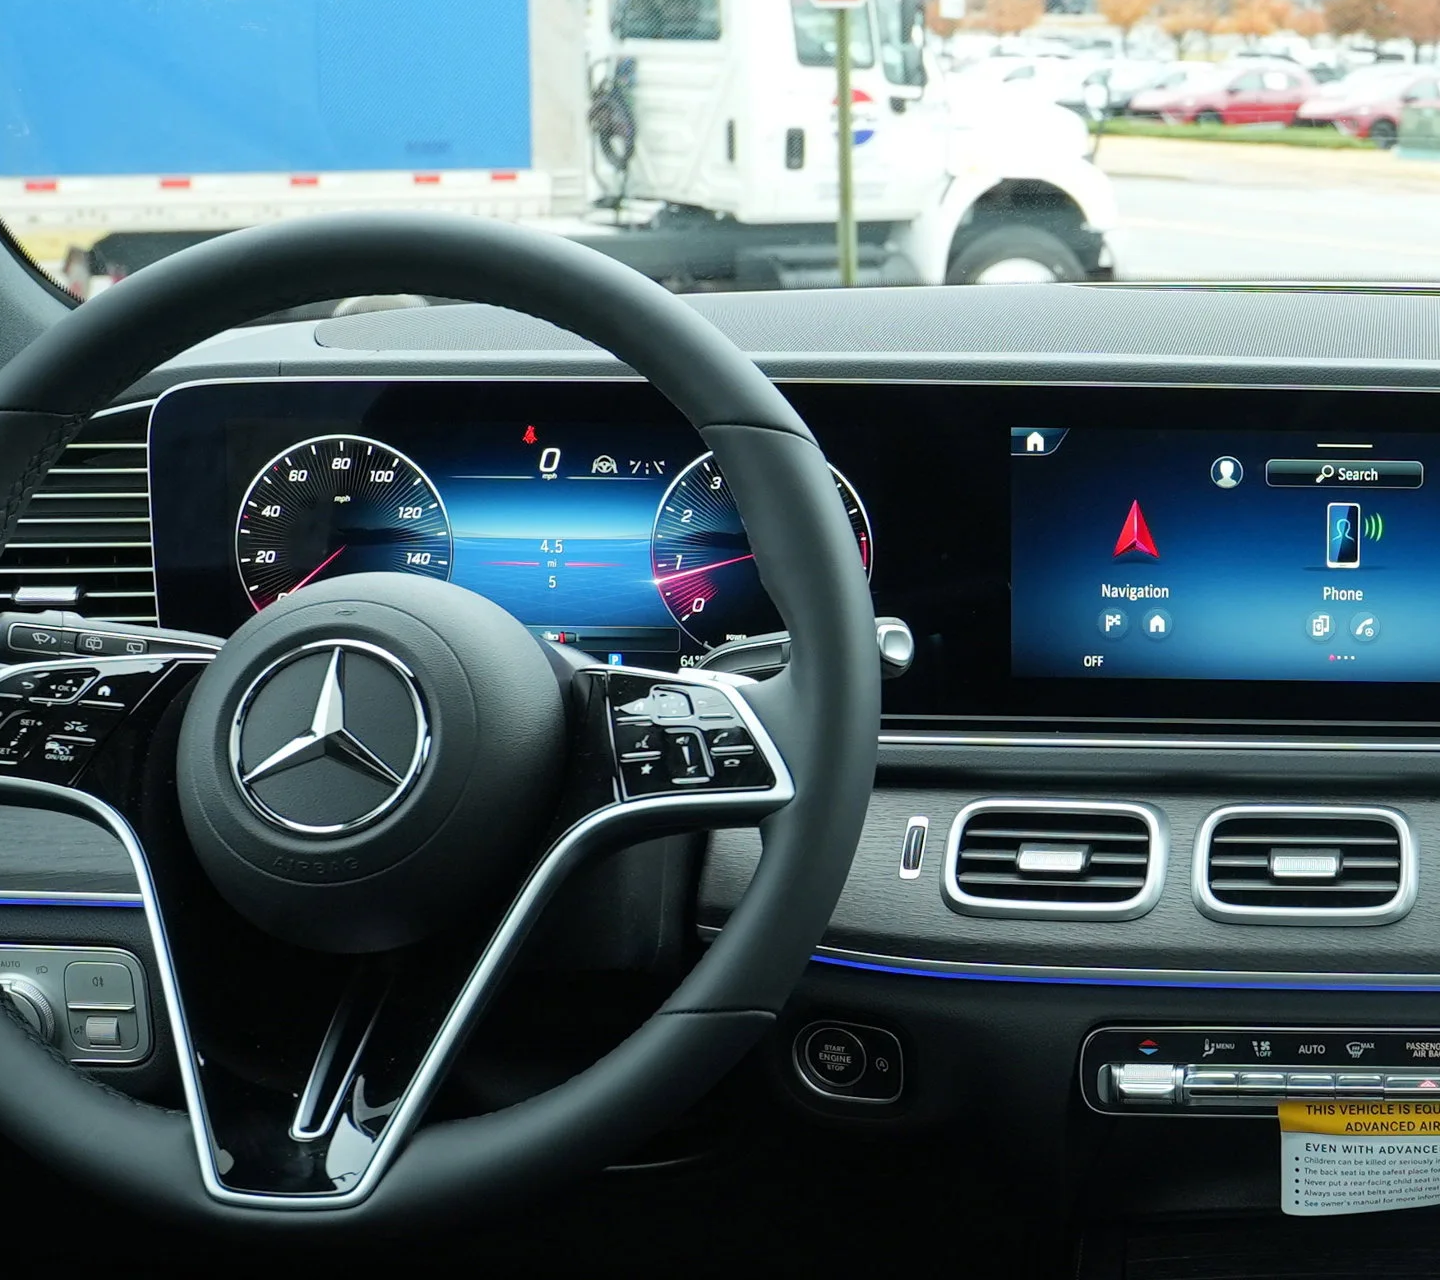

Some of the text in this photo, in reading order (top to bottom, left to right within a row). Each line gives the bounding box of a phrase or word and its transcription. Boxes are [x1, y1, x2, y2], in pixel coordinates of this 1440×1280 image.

[332, 458, 350, 469] 80
[539, 448, 561, 472] 0
[288, 470, 307, 482] 60
[370, 470, 394, 483] 100
[542, 472, 558, 480] mph
[1338, 467, 1378, 481] Search
[710, 476, 722, 490] 3
[334, 495, 350, 504] mph
[261, 505, 281, 517] 40
[398, 507, 422, 518] 120
[680, 509, 693, 523] 2
[540, 540, 563, 553] 4.5
[255, 551, 276, 563] 20
[406, 553, 431, 565] 140
[675, 555, 683, 570] 1
[547, 559, 557, 567] mi
[548, 576, 557, 588] 5
[1101, 584, 1169, 600] Navigation
[1323, 586, 1363, 602] Phone
[692, 598, 705, 612] 0
[612, 655, 619, 664] P
[1083, 656, 1104, 668] OFF
[45, 754, 74, 762] ON/OFF
[273, 855, 360, 875] AIRBAG
[0, 960, 20, 968] AUTO
[824, 1044, 845, 1052] START
[1298, 1045, 1325, 1054] AUTO
[819, 1053, 852, 1063] ENGINE
[1413, 1050, 1427, 1058] AIR
[1306, 1105, 1335, 1116] THIS
[1340, 1105, 1394, 1116] VEHICLE
[1399, 1105, 1410, 1115] IS
[1345, 1122, 1415, 1131] ADVANCED
[1420, 1122, 1440, 1131] AIR
[1305, 1143, 1337, 1153] EVEN
[1342, 1145, 1373, 1154] WITH
[1304, 1157, 1335, 1165] Children
[1354, 1158, 1363, 1166] be
[1365, 1158, 1386, 1166] killed
[1399, 1158, 1433, 1166] seriously
[1320, 1168, 1338, 1176] back
[1408, 1168, 1428, 1176] place
[1393, 1177, 1412, 1185] child
[1304, 1190, 1330, 1198] Always
[1367, 1188, 1386, 1196] belts
[1404, 1186, 1423, 1194] child
[1353, 1198, 1380, 1206] manual
